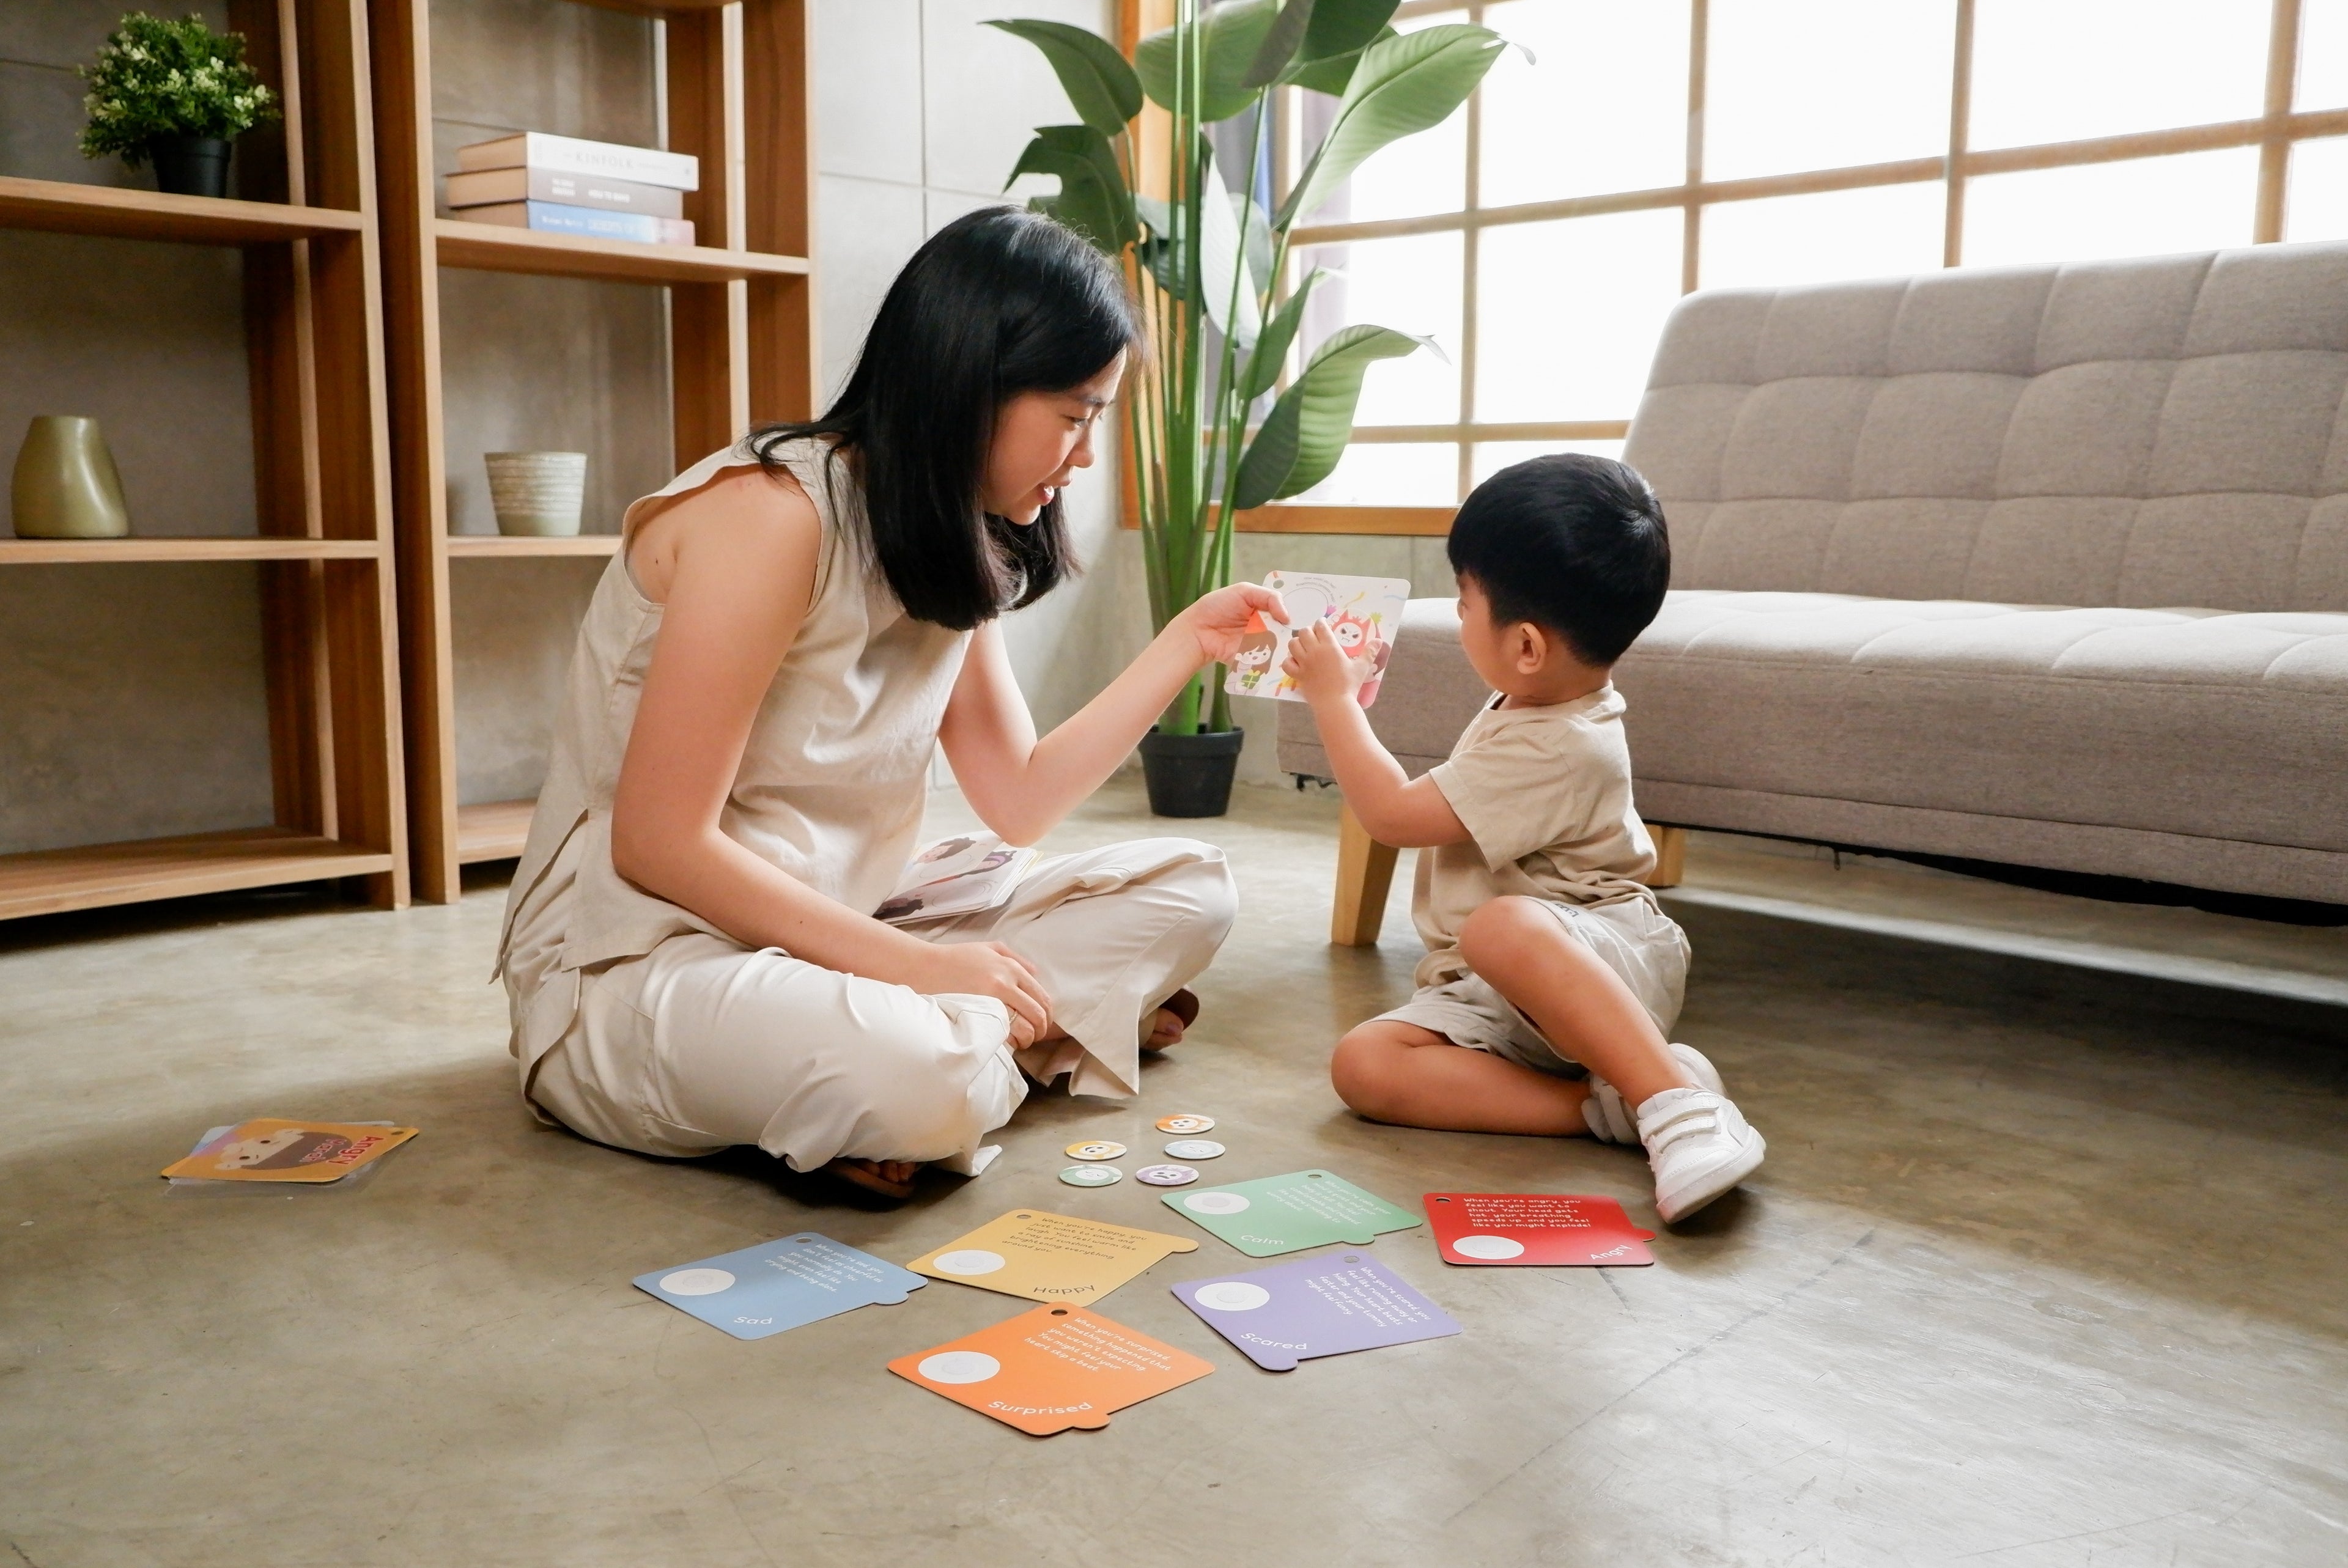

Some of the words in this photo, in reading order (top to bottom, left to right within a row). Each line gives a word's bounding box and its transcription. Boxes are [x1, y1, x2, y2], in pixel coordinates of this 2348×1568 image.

[576, 152, 634, 169] KINFOLK
[326, 1135, 385, 1165] Angry
[1010, 1235, 1063, 1249] brightening
[1065, 1248, 1115, 1259] everything
[1240, 1234, 1284, 1245] Calm
[1590, 1244, 1633, 1261] Angry
[1033, 1283, 1096, 1295] Happy
[1305, 1279, 1326, 1292] might
[1323, 1293, 1339, 1301] feel
[1347, 1271, 1363, 1279] feel
[1369, 1288, 1393, 1305] running
[1391, 1305, 1409, 1317] away
[1360, 1267, 1377, 1279] When
[1373, 1279, 1396, 1294] you're
[1415, 1311, 1431, 1320] you
[1320, 1276, 1340, 1290] faster
[1346, 1300, 1365, 1309] your
[1364, 1310, 1387, 1327] tummy
[1351, 1287, 1367, 1298] Your
[1365, 1298, 1385, 1312] heart
[1383, 1311, 1403, 1325] beats
[733, 1316, 773, 1325] Sad
[1074, 1317, 1096, 1330] When
[1095, 1328, 1125, 1341] you're
[1025, 1338, 1051, 1350] heart
[1050, 1350, 1069, 1358] skip
[1038, 1333, 1054, 1341] You
[1054, 1341, 1081, 1353] might
[1082, 1352, 1101, 1361] feel
[1097, 1360, 1121, 1369] your
[1061, 1323, 1106, 1344] something
[1106, 1342, 1151, 1361] happened
[1150, 1360, 1172, 1371] that
[1066, 1336, 1101, 1352] weren't
[1240, 1332, 1307, 1350] Scared
[988, 1400, 1094, 1416] Surprised
